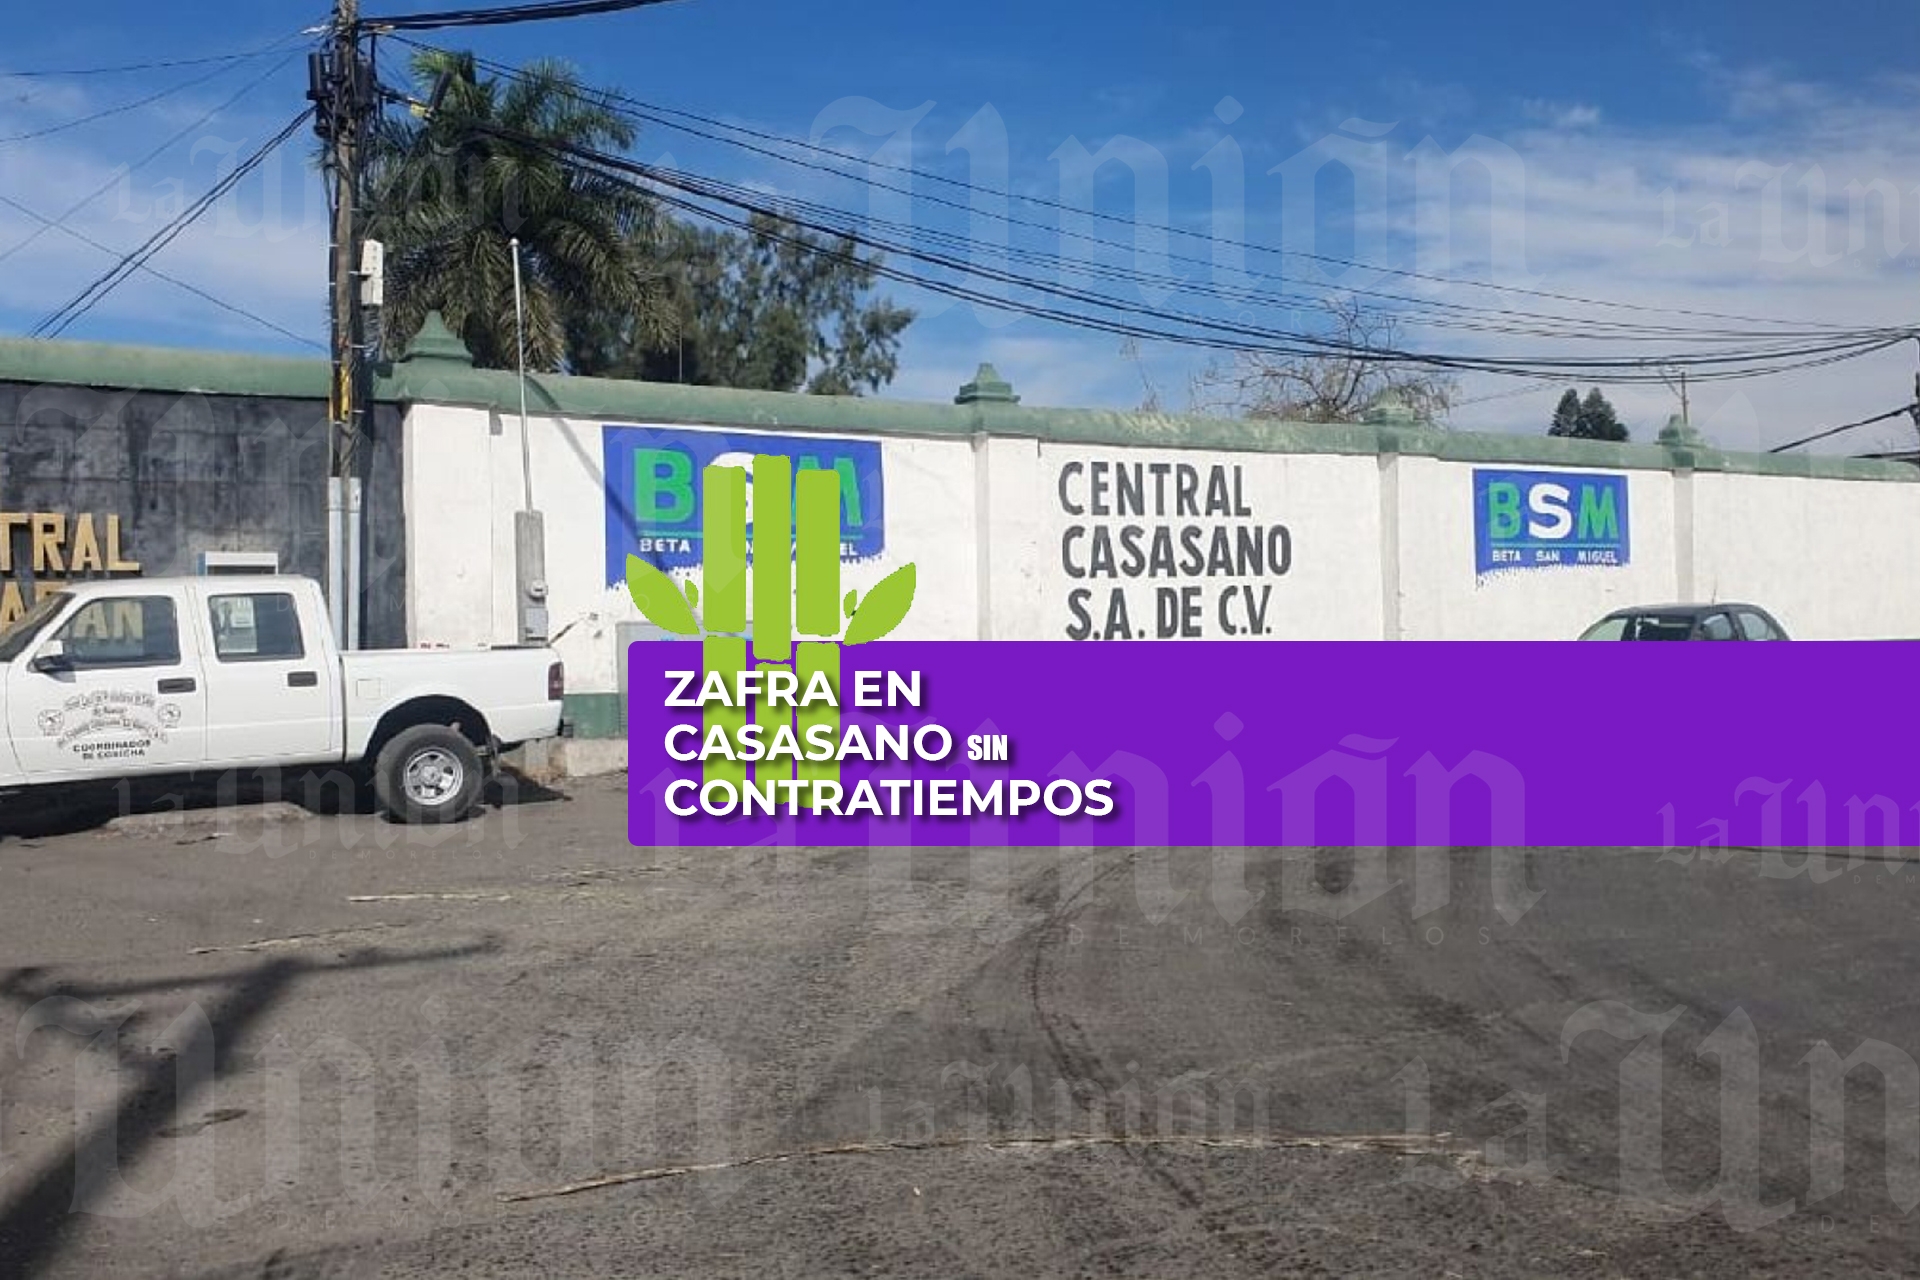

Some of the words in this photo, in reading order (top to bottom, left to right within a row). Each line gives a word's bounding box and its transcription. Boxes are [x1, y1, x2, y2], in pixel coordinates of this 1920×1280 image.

[633, 448, 864, 527] BM
[1058, 461, 1252, 517] CENTRAL
[1488, 481, 1619, 539] BSM
[639, 538, 691, 554] BETA
[1062, 524, 1292, 579] CASASANO
[1492, 550, 1522, 562] BETA
[1535, 550, 1561, 562] SAN
[1576, 550, 1618, 564] MIGUEL
[1065, 587, 1145, 640] S.A.
[1156, 586, 1202, 639] DE
[1218, 584, 1272, 636] C.V.
